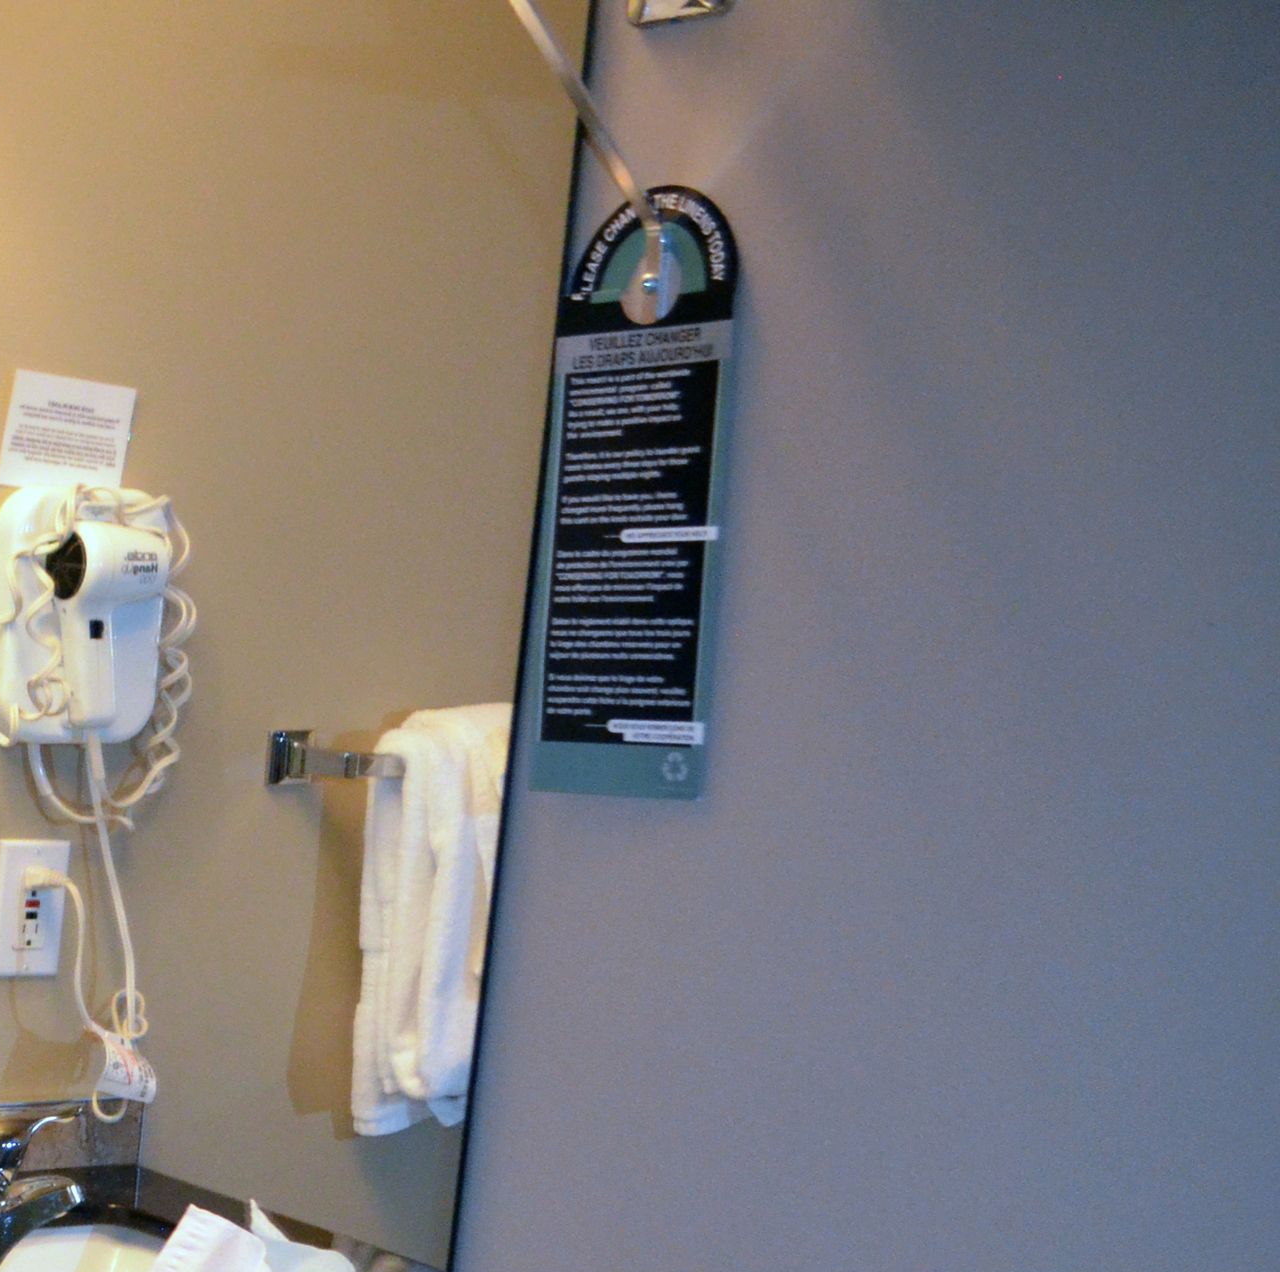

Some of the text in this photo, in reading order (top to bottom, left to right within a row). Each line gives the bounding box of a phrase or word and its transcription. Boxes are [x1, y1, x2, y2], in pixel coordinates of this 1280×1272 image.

[603, 207, 637, 242] CHAN
[653, 193, 680, 211] THE
[706, 231, 726, 281] TODAY
[572, 355, 594, 370] LES
[596, 351, 635, 368] DRAPS
